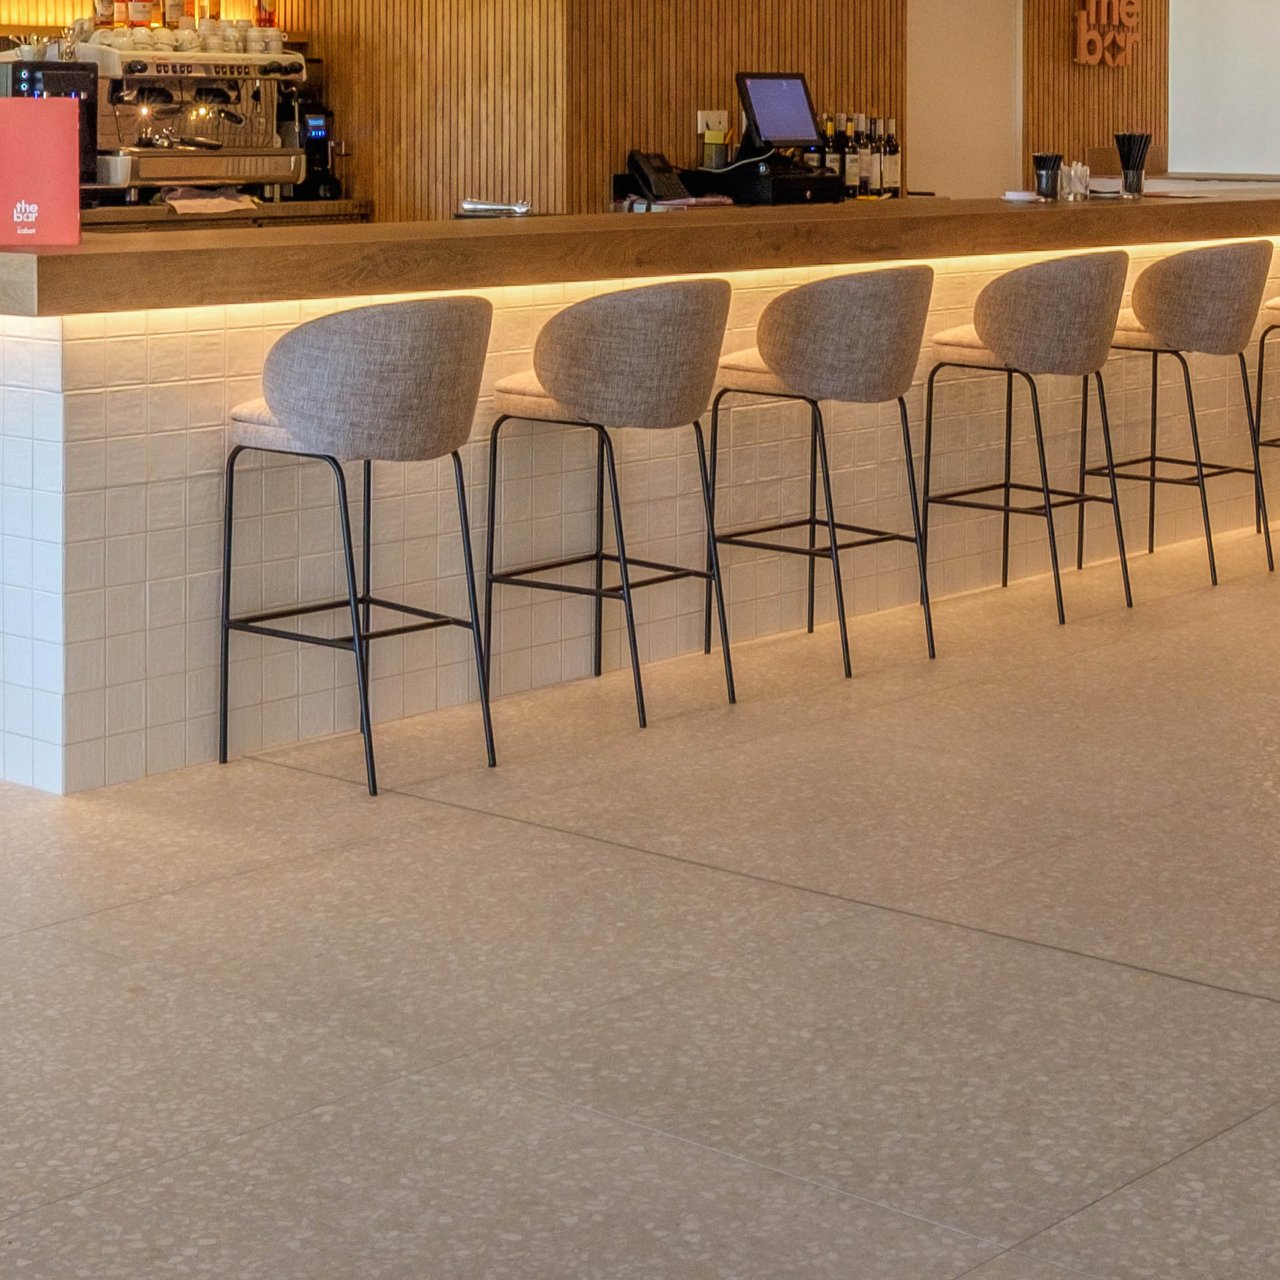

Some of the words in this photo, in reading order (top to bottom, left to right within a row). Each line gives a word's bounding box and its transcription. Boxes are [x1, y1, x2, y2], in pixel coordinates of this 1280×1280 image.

[1075, 10, 1141, 67] bar
[16, 199, 39, 213] the
[13, 208, 39, 222] bar
